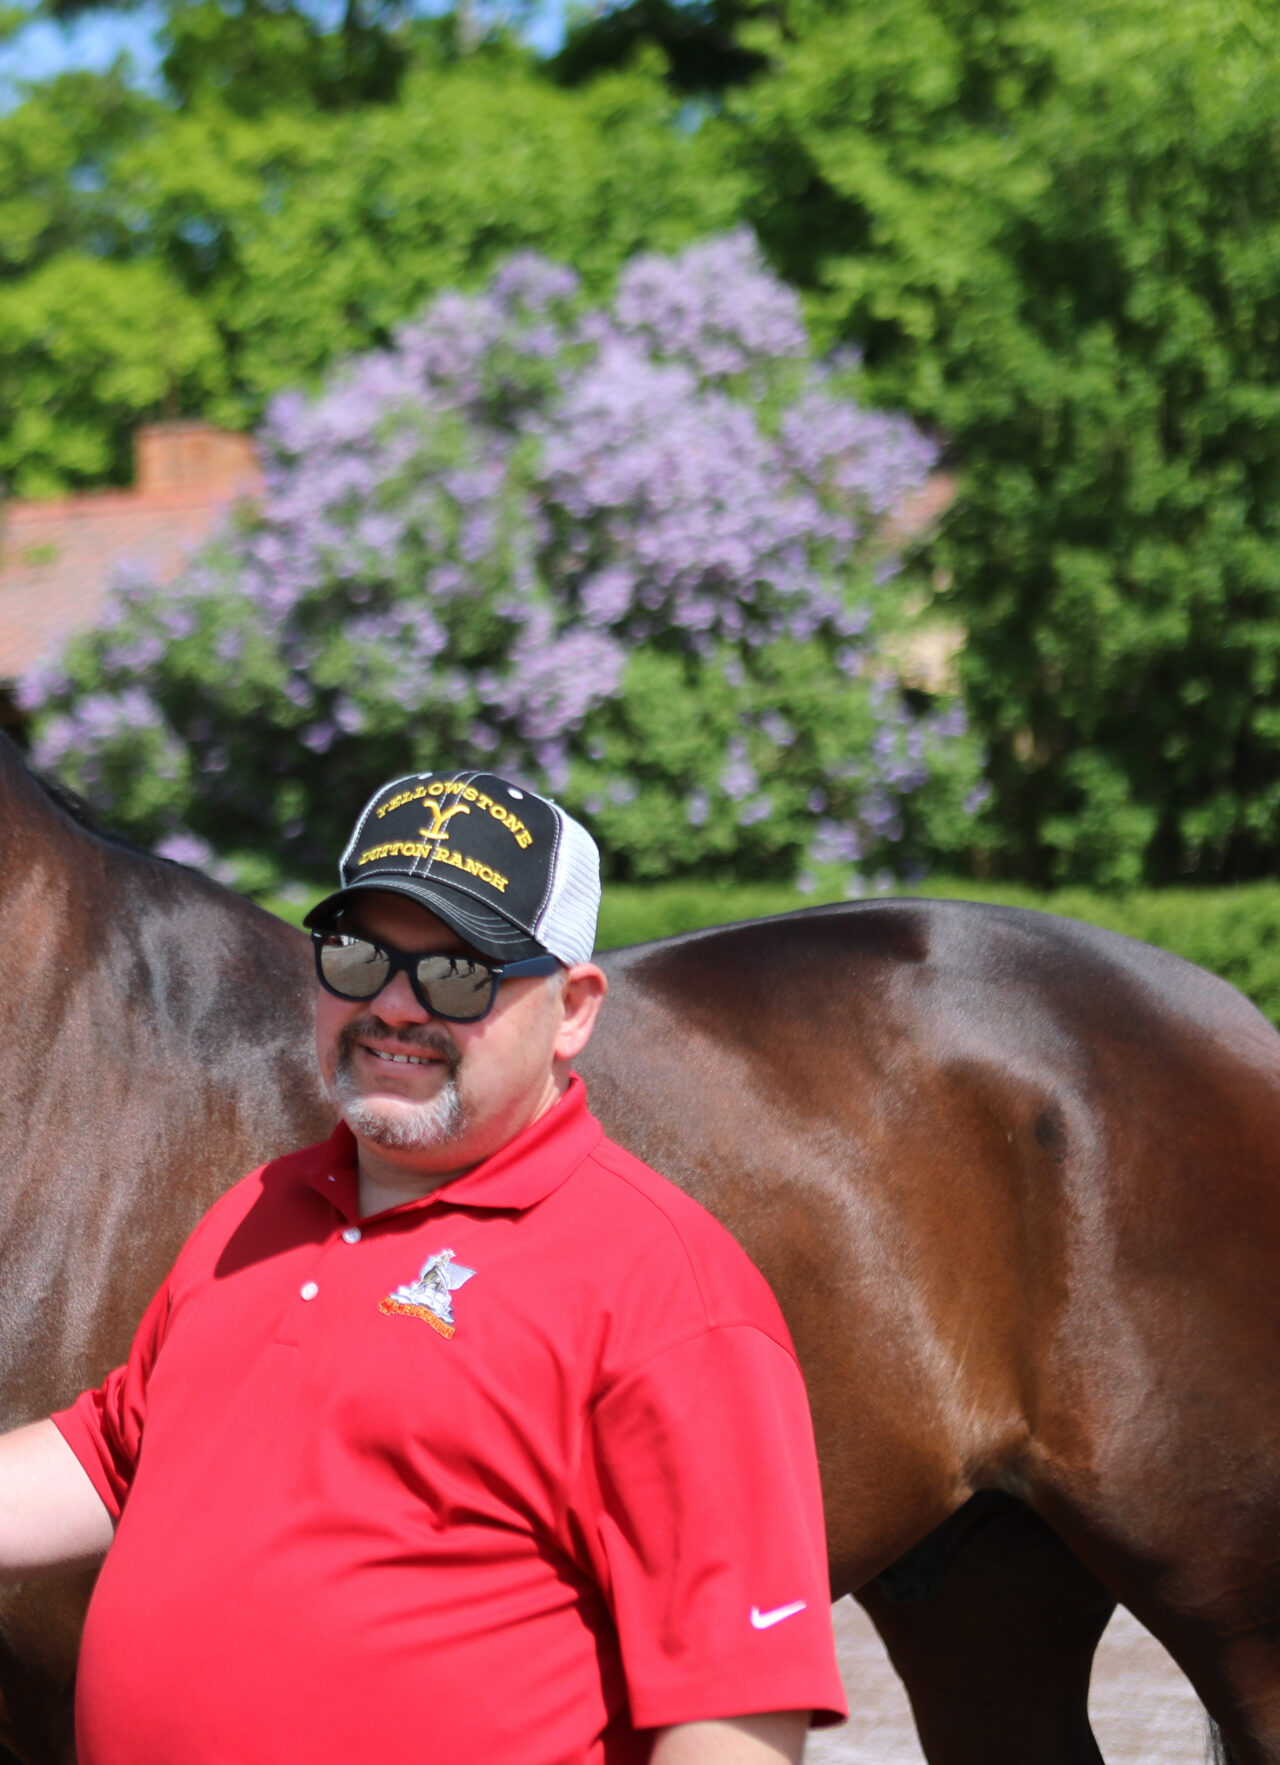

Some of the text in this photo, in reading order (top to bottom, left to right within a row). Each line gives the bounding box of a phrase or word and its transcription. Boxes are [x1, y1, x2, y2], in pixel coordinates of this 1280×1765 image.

[376, 781, 534, 849] YELLOWSTONE
[358, 842, 509, 893] DUTTON RANCH
